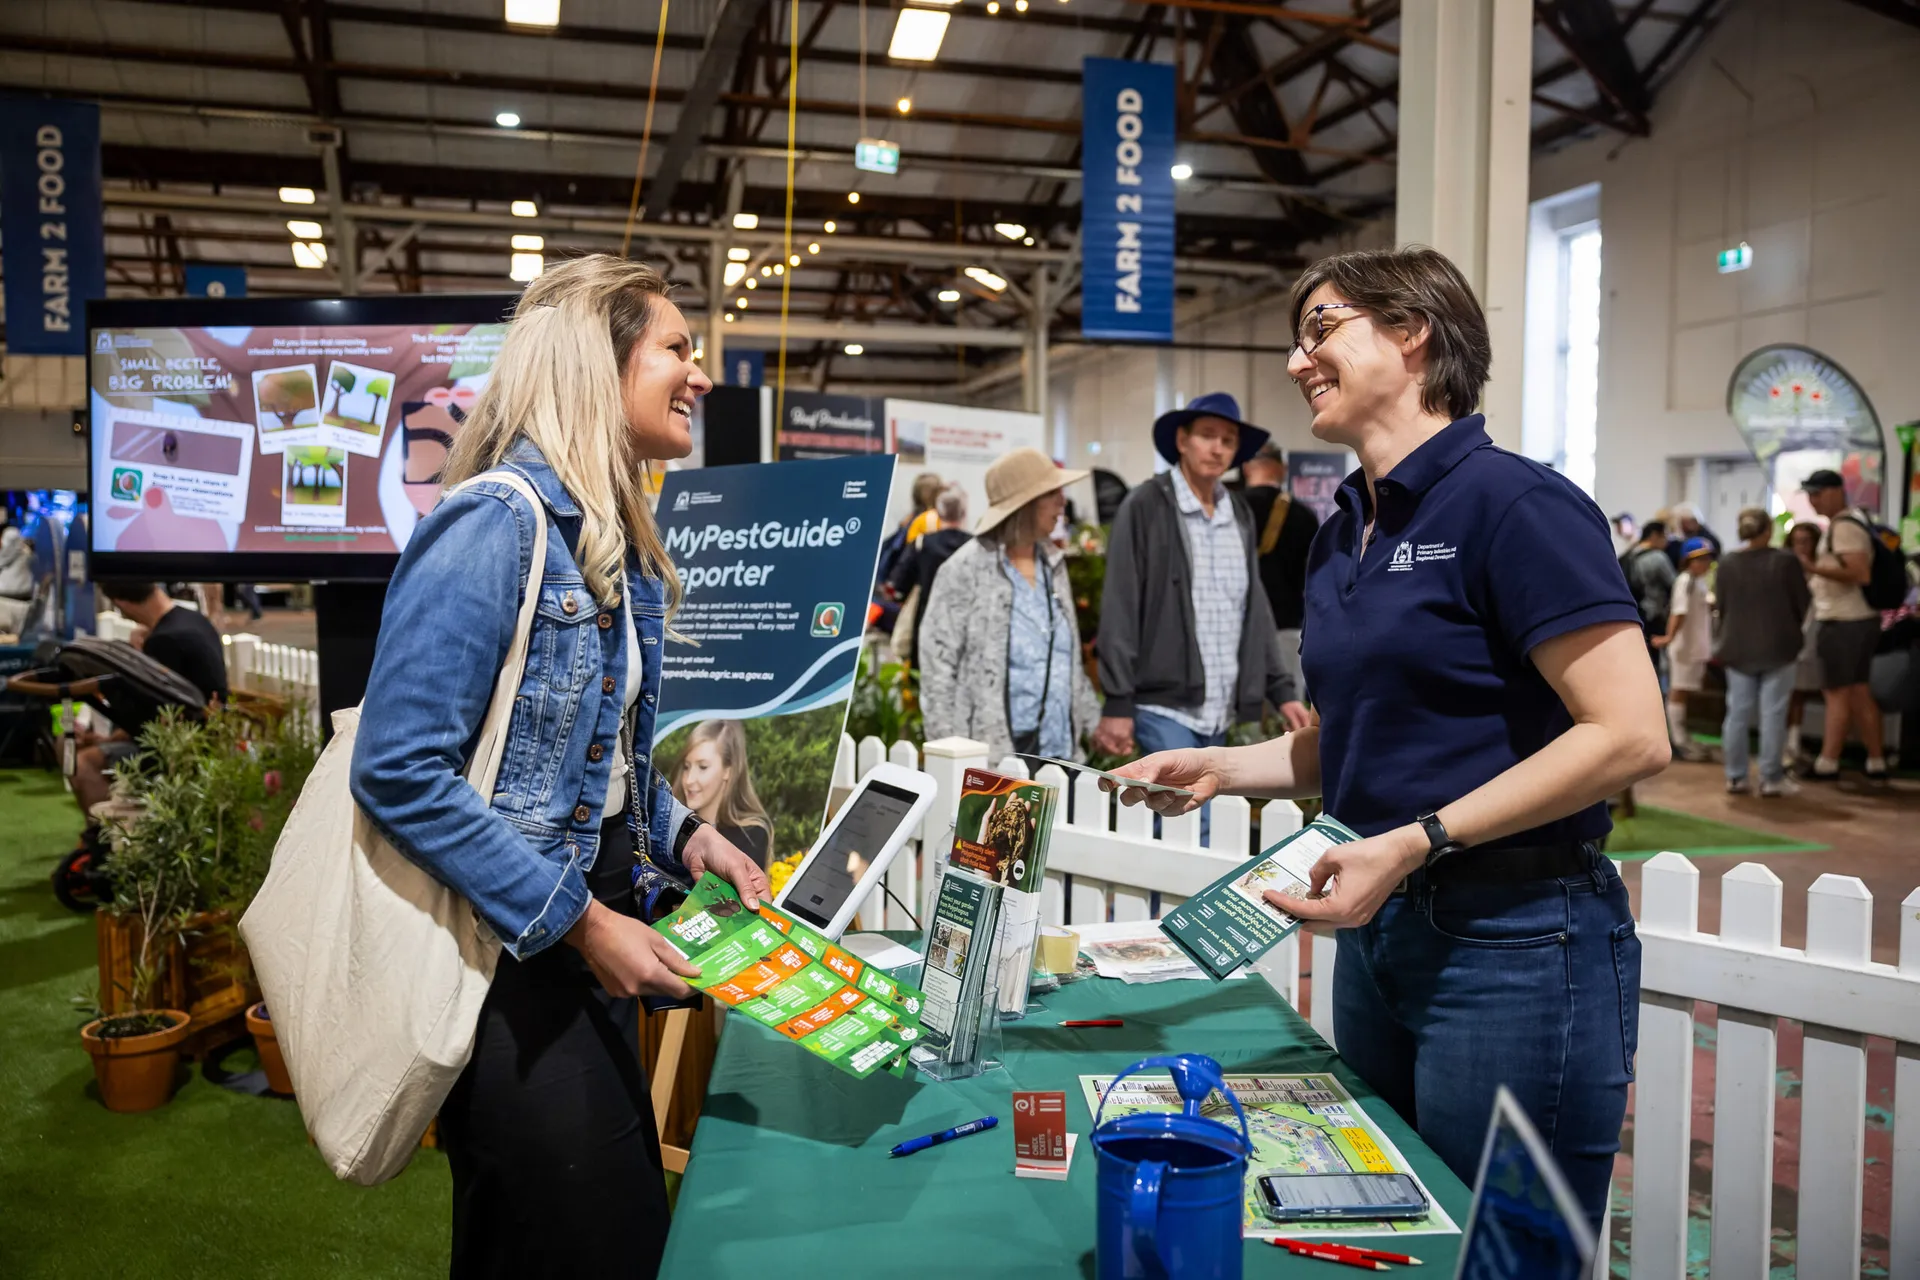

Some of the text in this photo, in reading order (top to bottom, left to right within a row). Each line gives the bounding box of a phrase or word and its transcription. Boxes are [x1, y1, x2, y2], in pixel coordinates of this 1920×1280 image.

[1115, 88, 1143, 314] FARM 2 FOOD
[36, 125, 70, 332] FARM 2 FOOD
[120, 358, 160, 372] SMALL
[108, 372, 232, 390] BIG PROBLEM!
[672, 560, 774, 595] eporter
[941, 893, 954, 904] Protect
[1214, 900, 1237, 917] garden
[1221, 888, 1282, 934] shot-hole borer (PSHB)
[1226, 900, 1262, 928] Polyphagous
[682, 916, 719, 942] DPIRD
[1234, 916, 1250, 928] your
[1248, 926, 1270, 944] Protect
[1262, 927, 1276, 940] from
[1219, 938, 1240, 958] Protect
